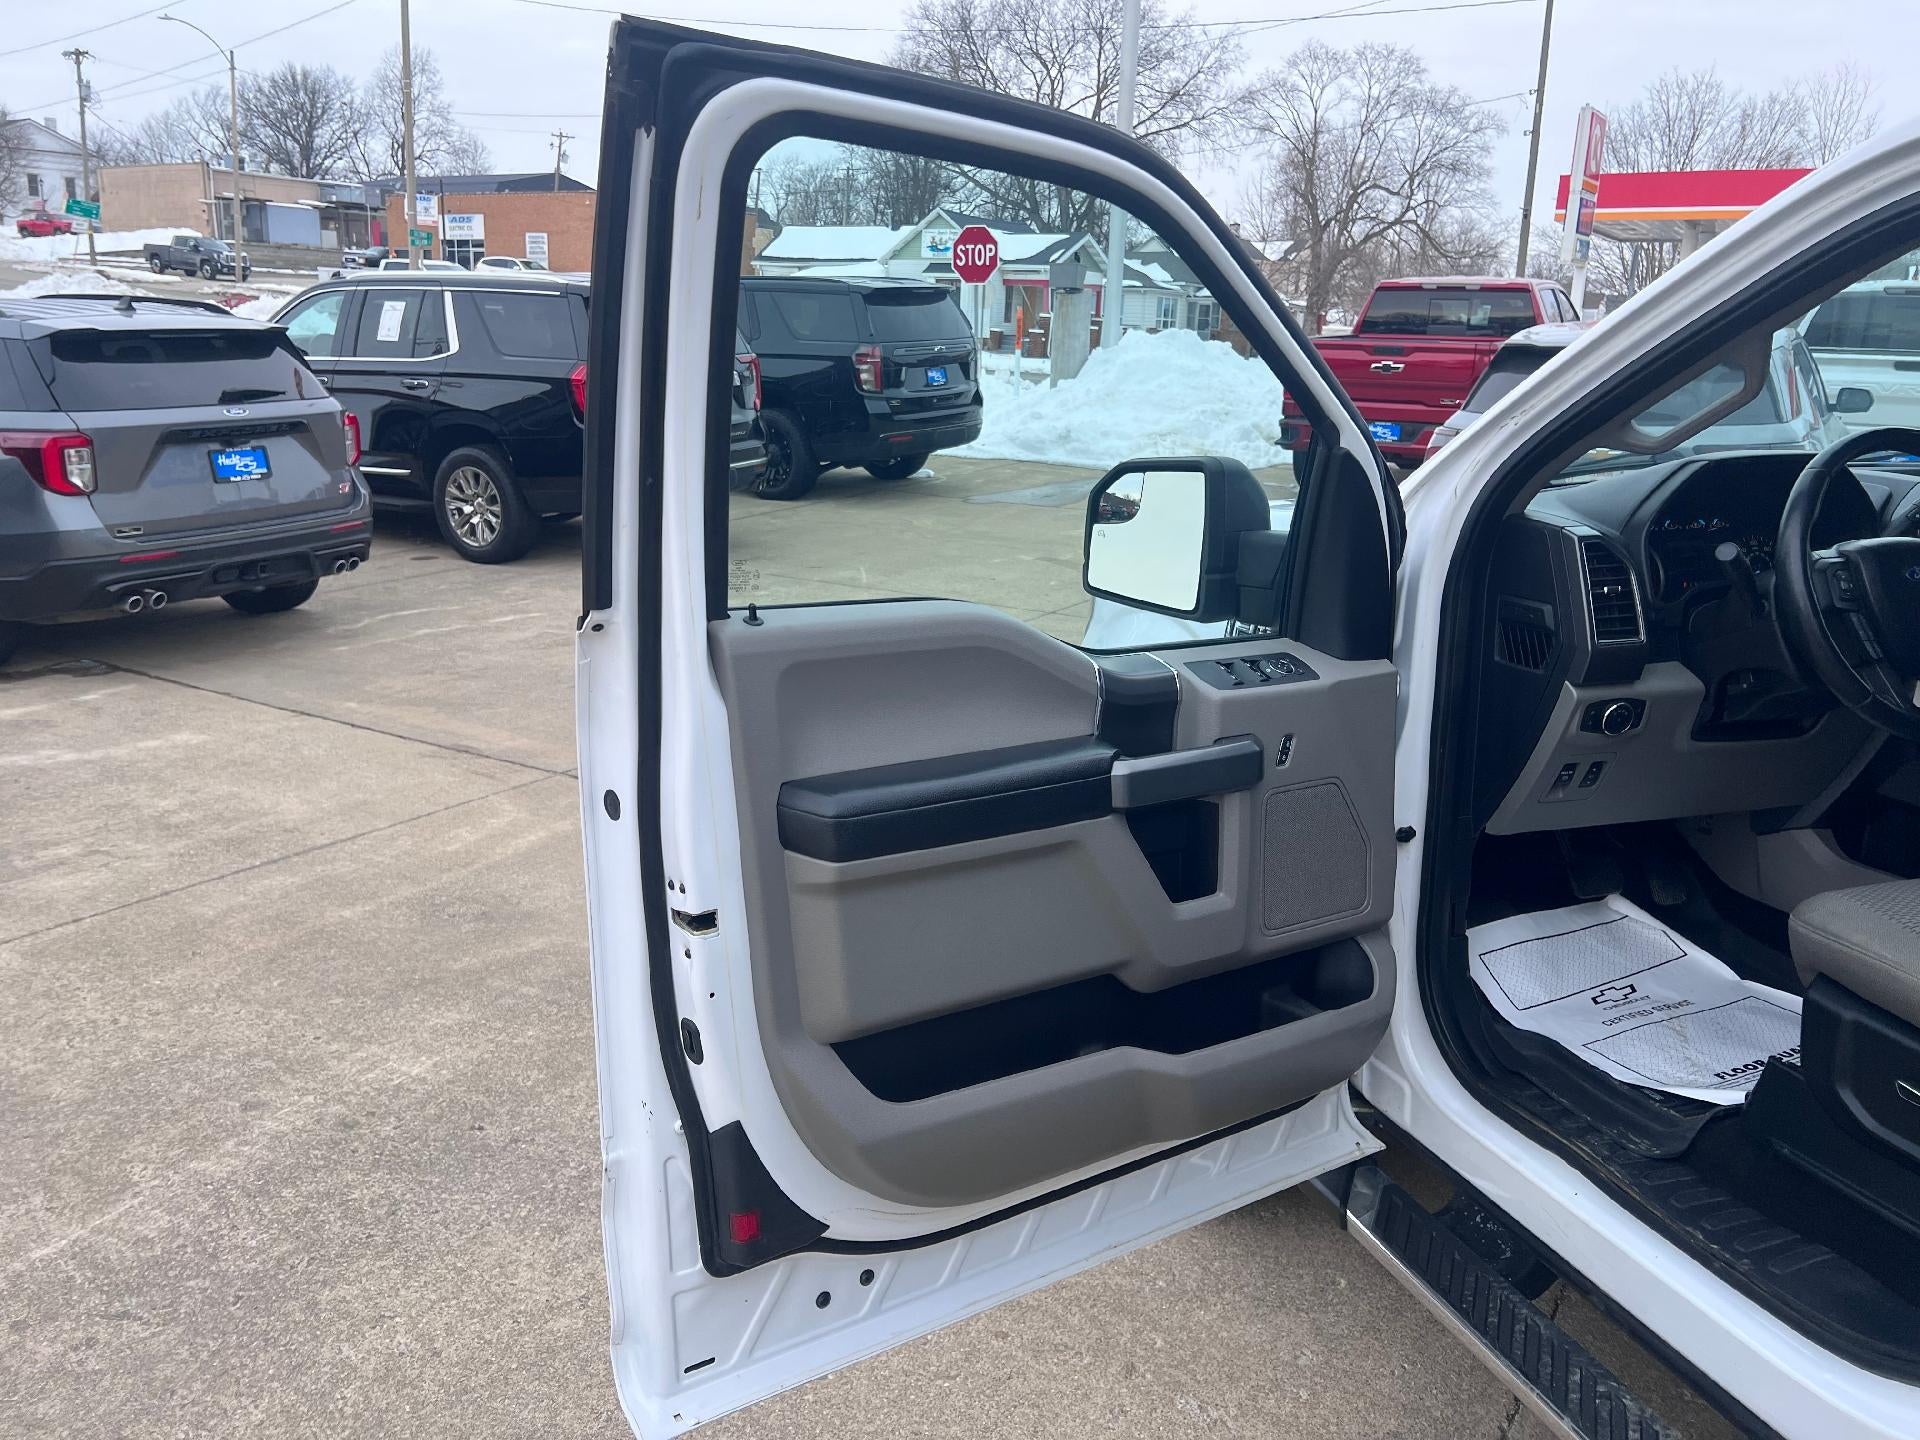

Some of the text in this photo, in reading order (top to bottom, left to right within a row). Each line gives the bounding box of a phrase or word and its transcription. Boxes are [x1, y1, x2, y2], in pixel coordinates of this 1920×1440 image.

[956, 244, 996, 266] STOP
[1602, 999, 1696, 1027] CERTIFIED SERVICE
[1713, 1059, 1767, 1080] FLOOR
